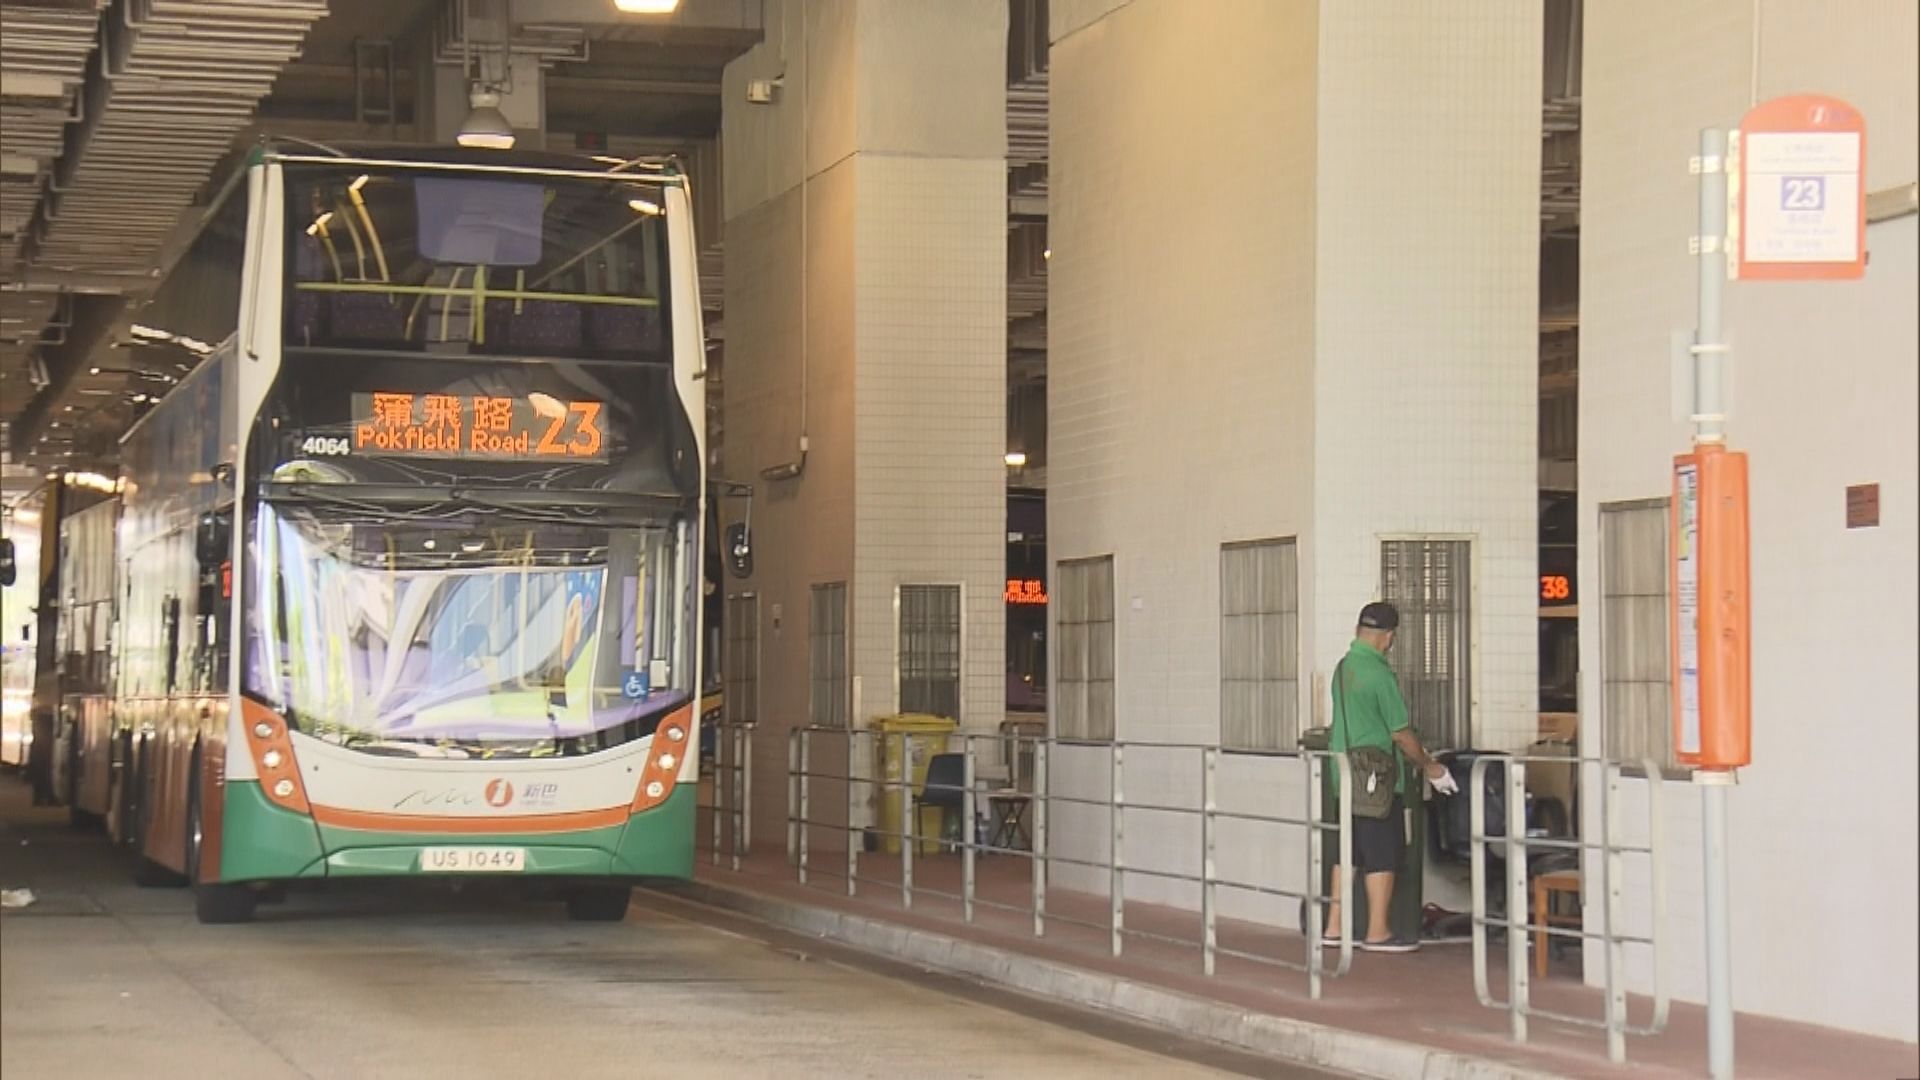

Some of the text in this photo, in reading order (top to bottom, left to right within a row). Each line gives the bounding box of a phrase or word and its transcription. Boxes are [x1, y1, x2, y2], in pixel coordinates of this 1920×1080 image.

[1785, 179, 1821, 208] 23
[373, 392, 513, 431] 蒲飛路
[356, 425, 528, 453] Pokfield Road
[533, 400, 601, 455] 23
[302, 436, 349, 455] 4064
[1541, 576, 1569, 599] 38
[523, 783, 558, 798] 新巴
[432, 851, 516, 867] US 1049
